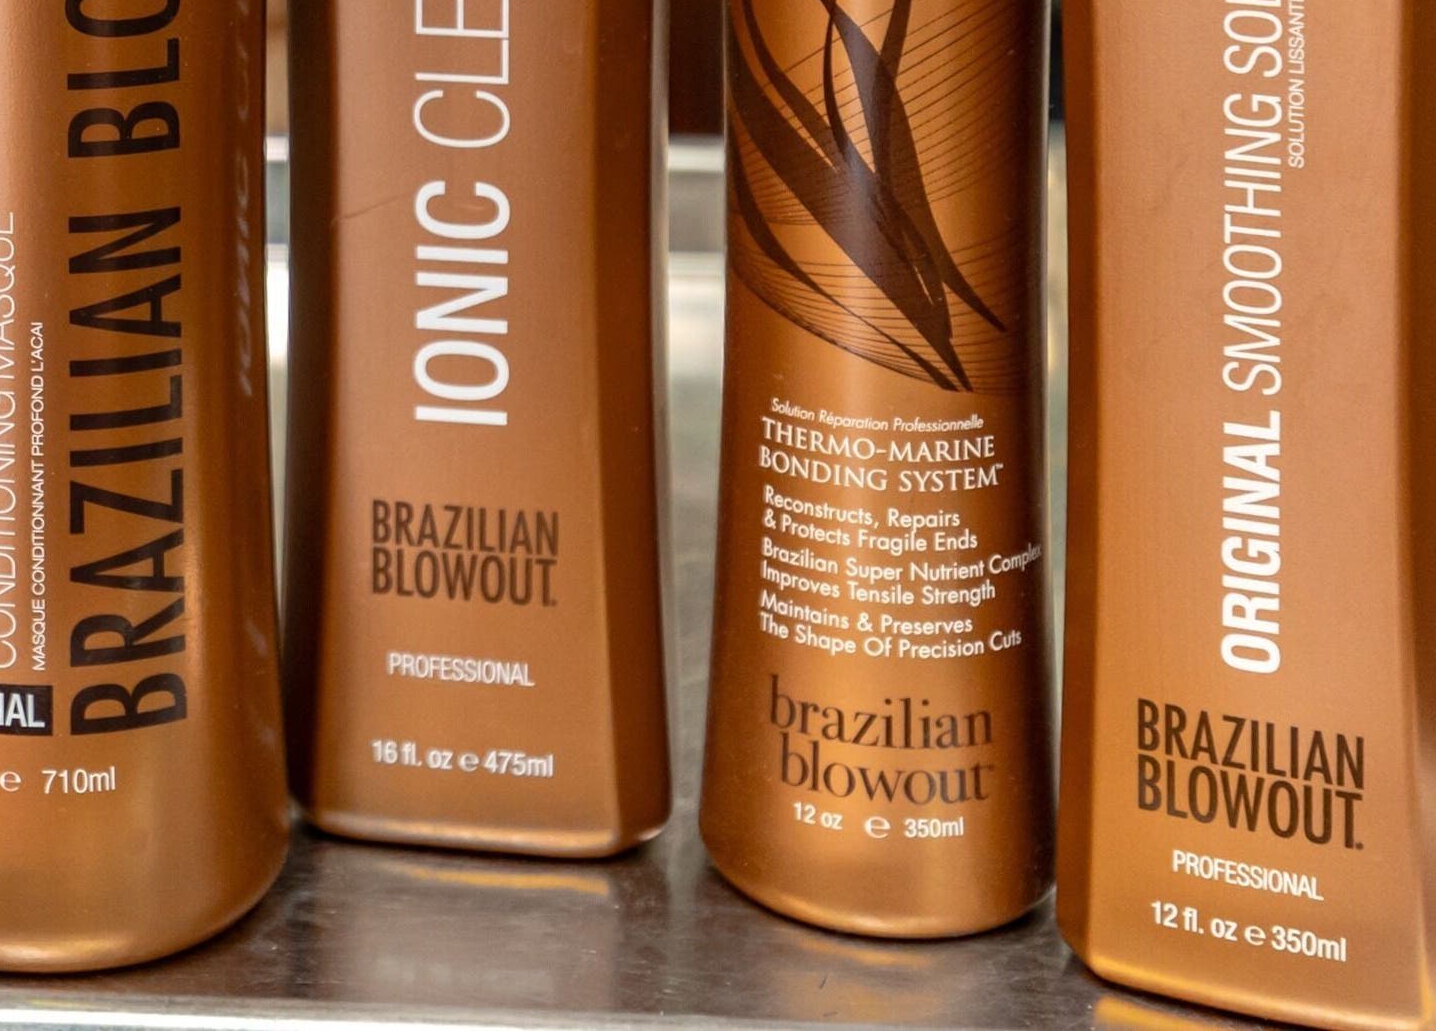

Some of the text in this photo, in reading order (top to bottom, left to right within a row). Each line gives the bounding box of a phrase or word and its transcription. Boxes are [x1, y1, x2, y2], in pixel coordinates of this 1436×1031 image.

[1288, 79, 1305, 169] SOLUTION
[1222, 93, 1283, 395] SMOOTHING
[414, 181, 510, 426] IONIC
[762, 416, 995, 463] THERMO-MARINE
[771, 398, 984, 433] Solution Réparation Professionnelle
[68, 206, 186, 735] BRAZILIAN
[760, 446, 888, 492] BONDING
[31, 322, 46, 670] MASQUE CONDITIONNANT PROFOND L'ACAI
[764, 485, 960, 533] Reconstructs, Repairs
[371, 499, 559, 557] BRAZILIAN
[765, 509, 978, 556] & Protects Fragile Ends
[1220, 410, 1282, 675] ORIGINAL
[763, 536, 838, 575] Brazilian
[845, 559, 902, 585] Super
[910, 562, 984, 582] Nutrient
[763, 560, 996, 607] Improves Tensile Strength
[760, 589, 973, 634] Maintains & Preserves
[761, 612, 1022, 659] The Shape Of Precision Cuts
[388, 652, 536, 687] PROFESSIONAL
[770, 674, 993, 749] brazilian
[371, 740, 398, 764] 16
[402, 743, 423, 767] fl.
[427, 750, 453, 770] oz
[483, 750, 554, 778] 475ml
[1137, 698, 1364, 790] BRAZILIAN
[42, 766, 116, 794] 710ml
[793, 802, 816, 824] 12
[820, 813, 843, 830] oz
[904, 816, 965, 838] 350ml
[1172, 849, 1325, 901] PROFESSIONAL
[1151, 901, 1179, 929] 12
[1182, 907, 1204, 935] fl.
[1210, 917, 1238, 942] oz
[1271, 925, 1347, 962] 350ml
